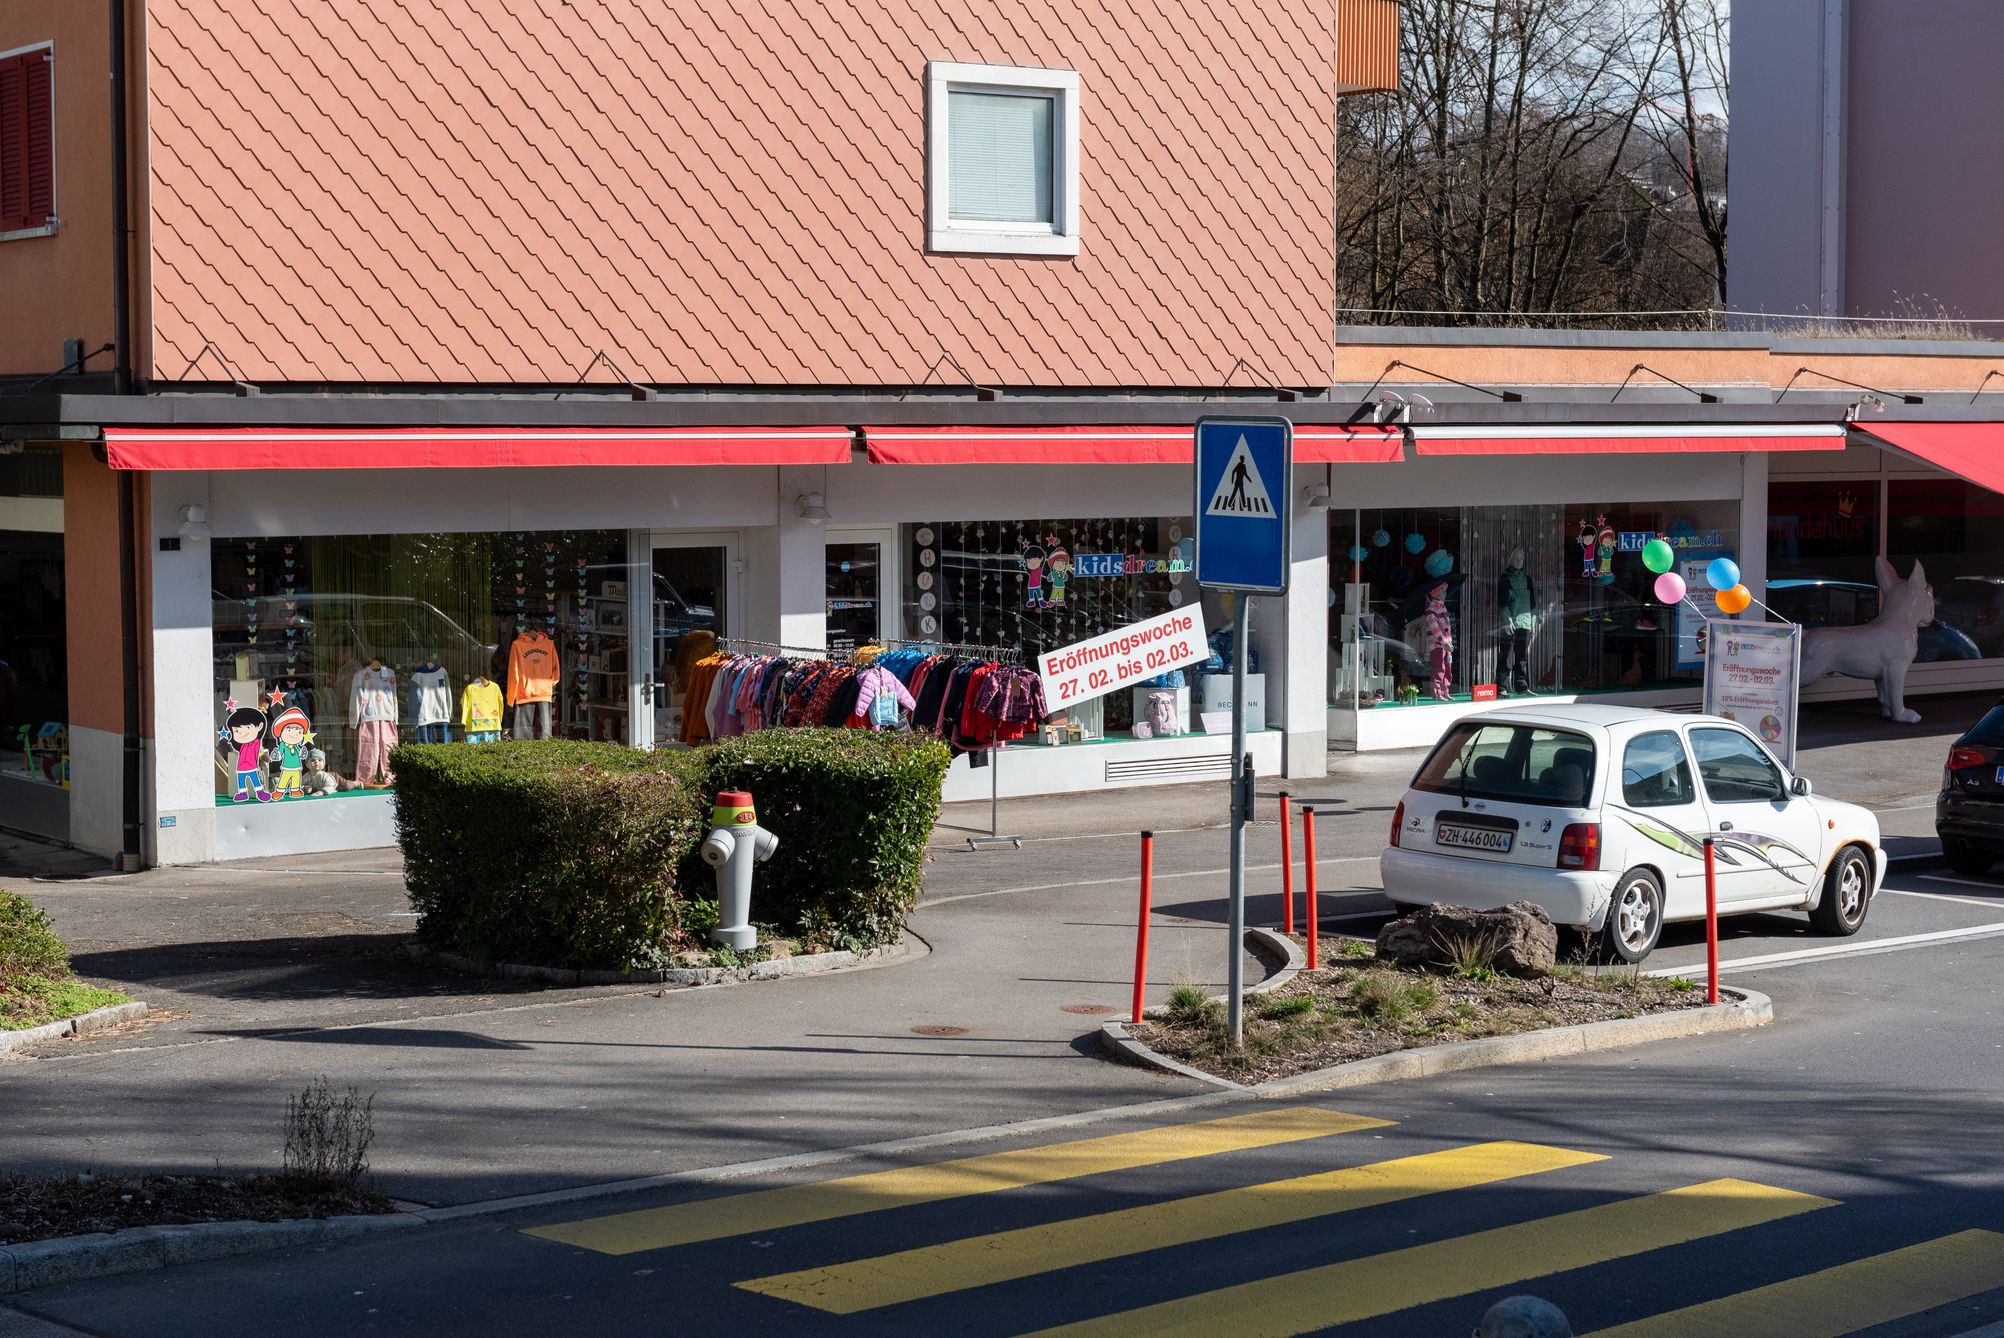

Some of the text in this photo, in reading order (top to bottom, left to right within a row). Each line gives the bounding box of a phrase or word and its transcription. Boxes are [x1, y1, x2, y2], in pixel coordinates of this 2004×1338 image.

[1077, 554, 1193, 575] kidsdream.
[1047, 616, 1193, 677] Eröffnungswoche
[1059, 641, 1194, 700] 27. 02. bis 02.03.
[1722, 663, 1782, 676] Eröffnungswoche
[1753, 675, 1775, 685] 02.03.
[1217, 700, 1258, 709] BECNN
